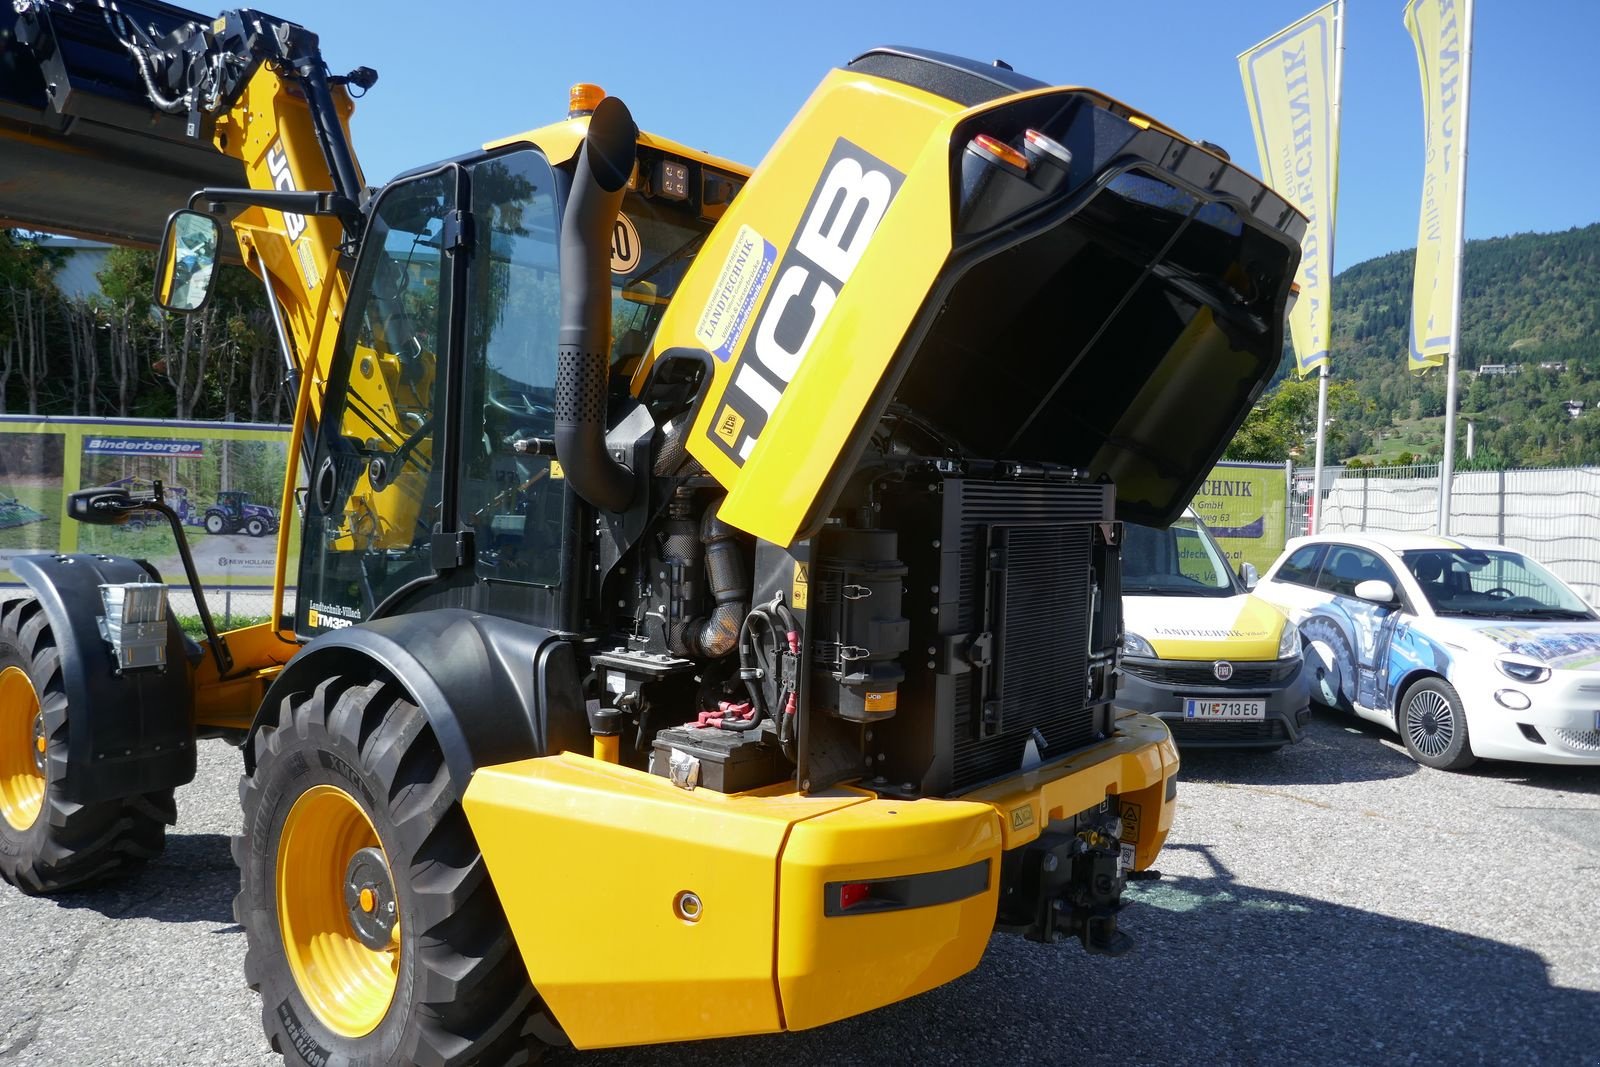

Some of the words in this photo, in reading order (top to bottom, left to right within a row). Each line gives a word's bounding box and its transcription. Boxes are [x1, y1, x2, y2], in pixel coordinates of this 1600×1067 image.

[267, 149, 305, 241] JCB
[705, 239, 754, 338] LANDTECHNIK
[728, 260, 773, 353] www.landtechnik.co.at
[736, 157, 892, 462] JCB
[721, 313, 734, 338] Villach
[722, 416, 737, 435] JCB
[88, 439, 200, 453] Binderberger
[1198, 501, 1224, 509] GmbH
[310, 600, 361, 619] Landtechnik-Villach
[1200, 702, 1211, 716] VI
[1221, 703, 1241, 716] 713
[1243, 703, 1258, 716] EG
